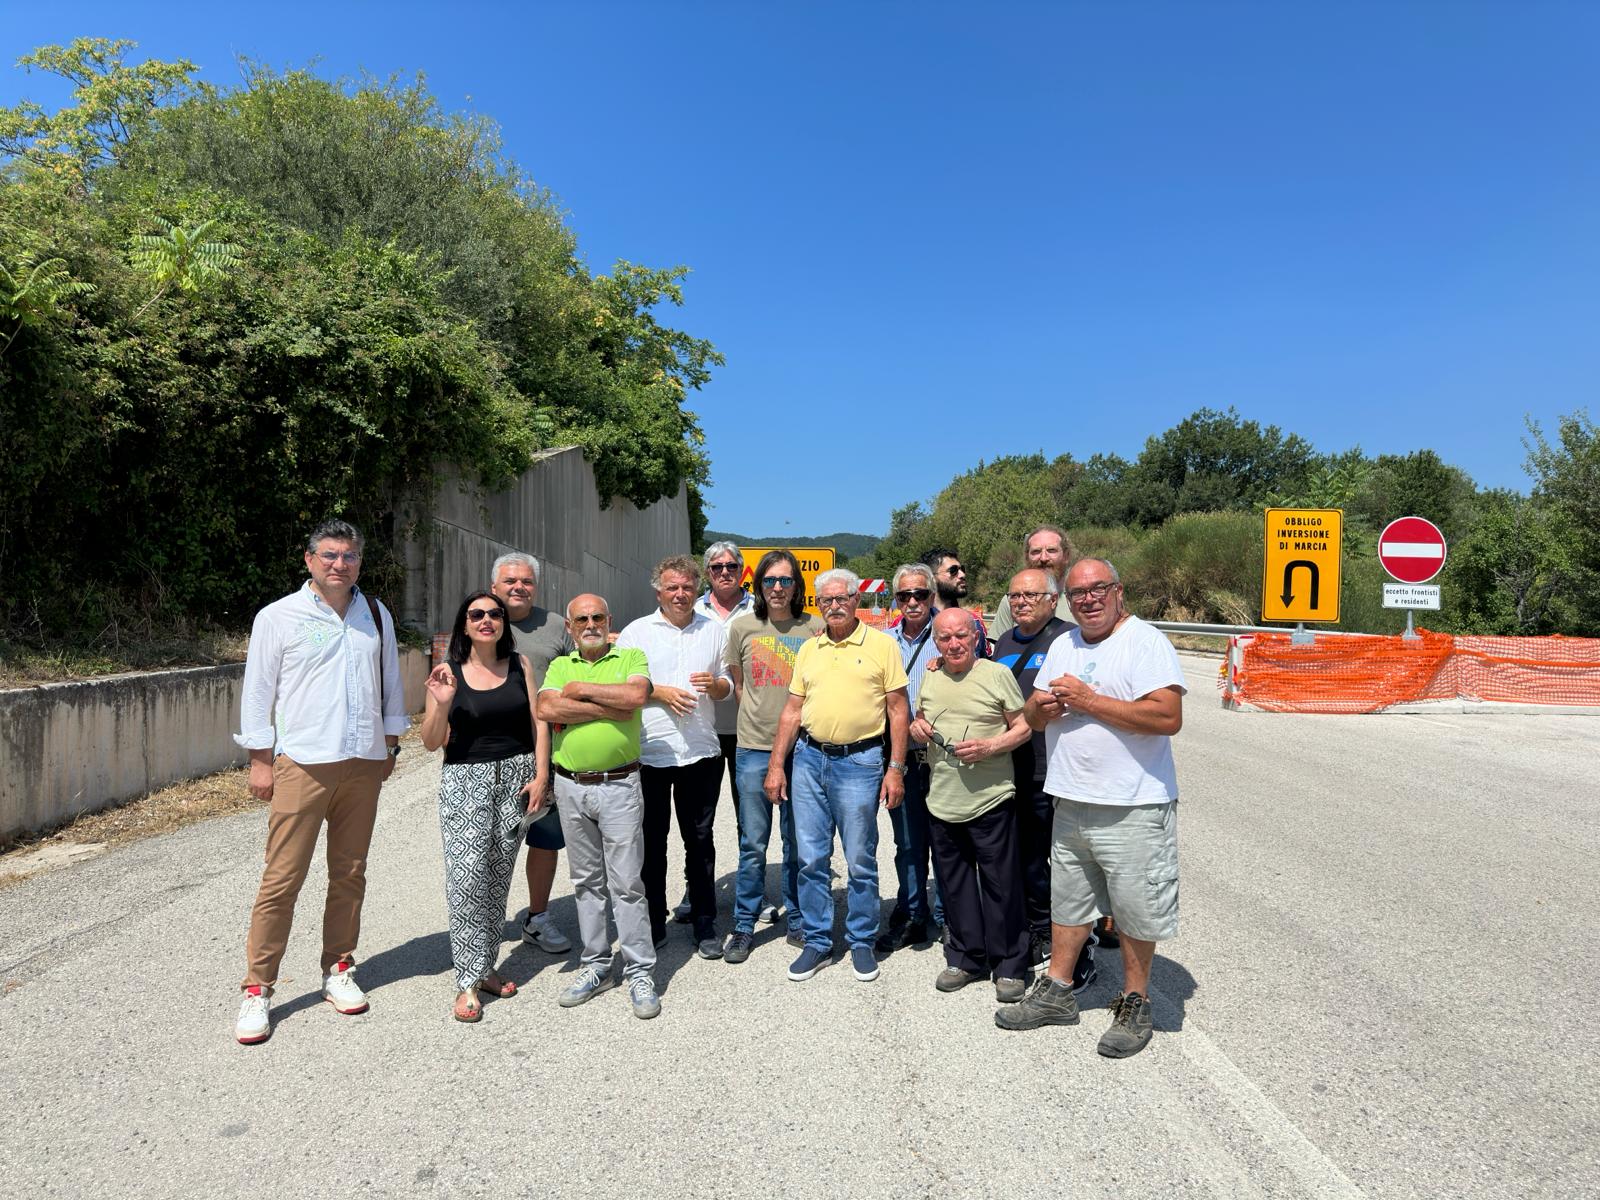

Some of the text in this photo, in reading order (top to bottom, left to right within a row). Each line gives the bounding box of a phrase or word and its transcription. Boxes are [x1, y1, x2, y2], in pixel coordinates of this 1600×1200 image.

[1285, 517, 1322, 526] OBBLIGO
[1277, 529, 1330, 539] INVERSIONE
[1279, 541, 1327, 551] DI MARCIA
[800, 560, 820, 571] ZIO
[1411, 588, 1438, 596] frontisti
